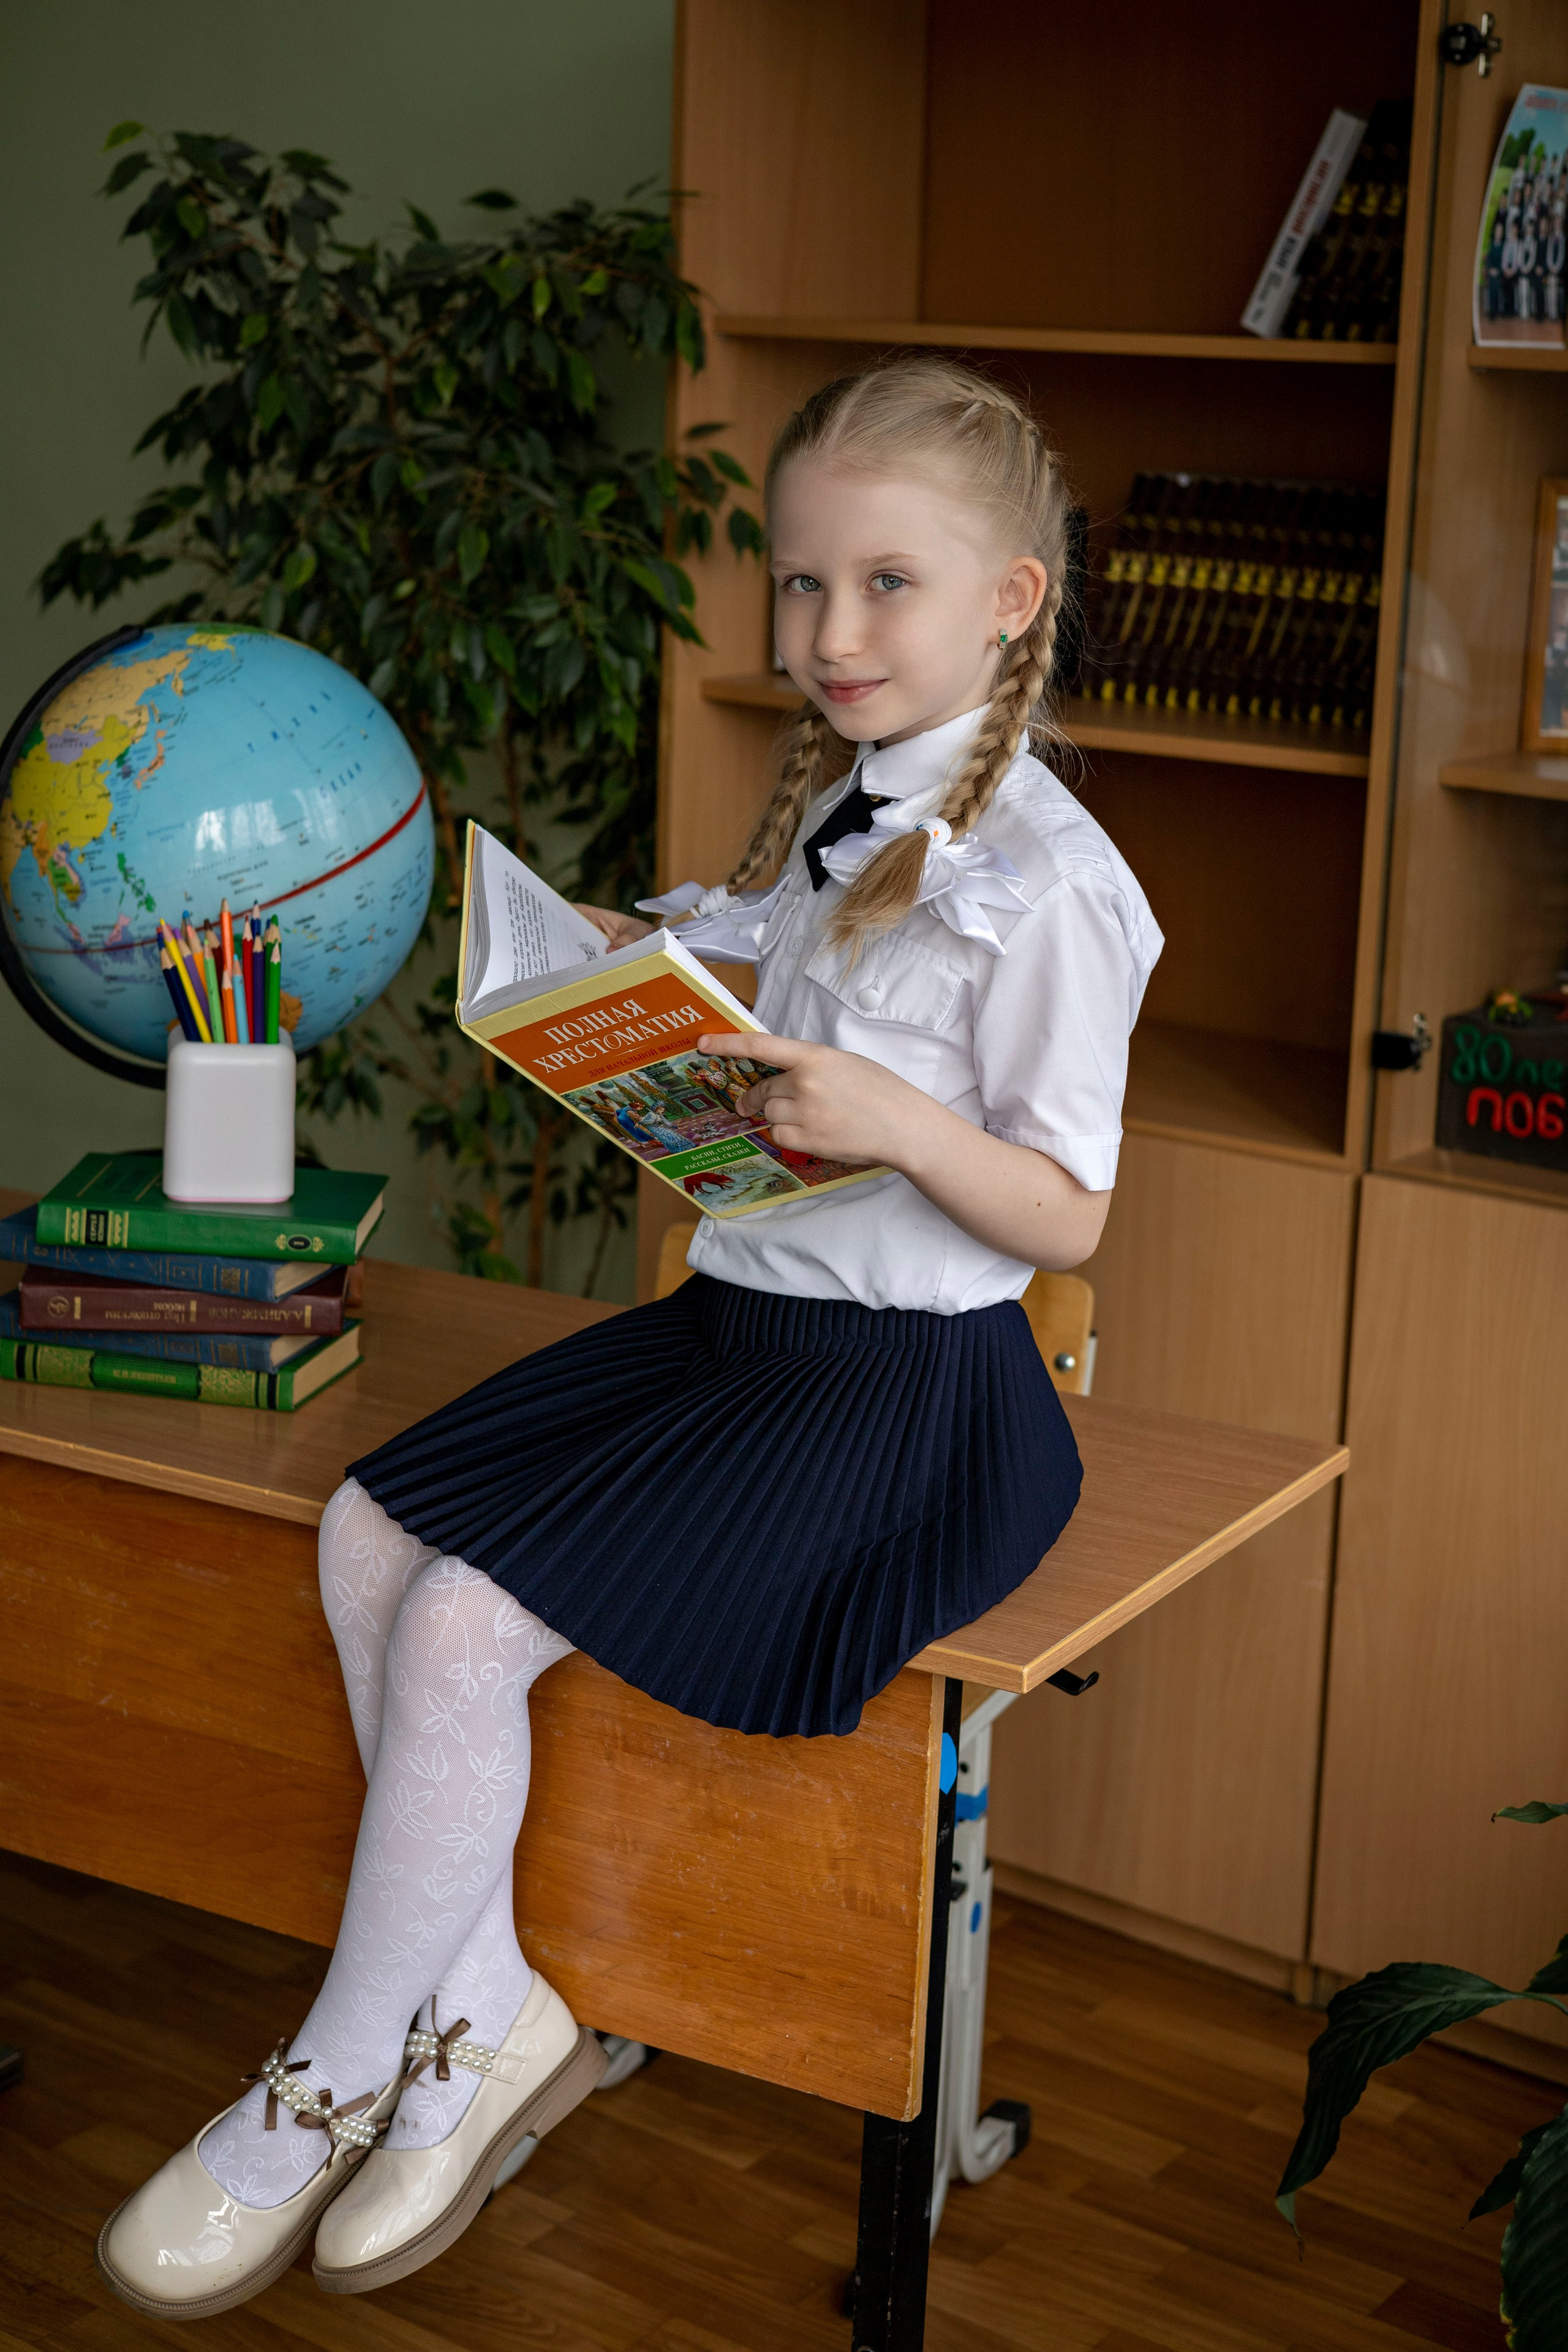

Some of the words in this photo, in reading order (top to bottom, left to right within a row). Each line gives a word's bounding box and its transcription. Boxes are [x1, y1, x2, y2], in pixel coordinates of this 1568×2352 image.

[532, 1005, 706, 1074] ХРЕСТОМАТИЯ
[543, 998, 649, 1045] ПОЛНАЯ
[588, 1066, 606, 1078] ДЛЯ
[607, 1048, 658, 1072] НАЧАЛЬНОЙ
[658, 1037, 692, 1054] ШКОЛЫ
[1451, 1024, 1513, 1085] 80
[684, 1155, 723, 1170] РАССКАЗЫ,
[722, 1147, 750, 1159] СКАЗКИ
[691, 1150, 718, 1161] БАСНИ,
[717, 1142, 744, 1153] СТИХИ,
